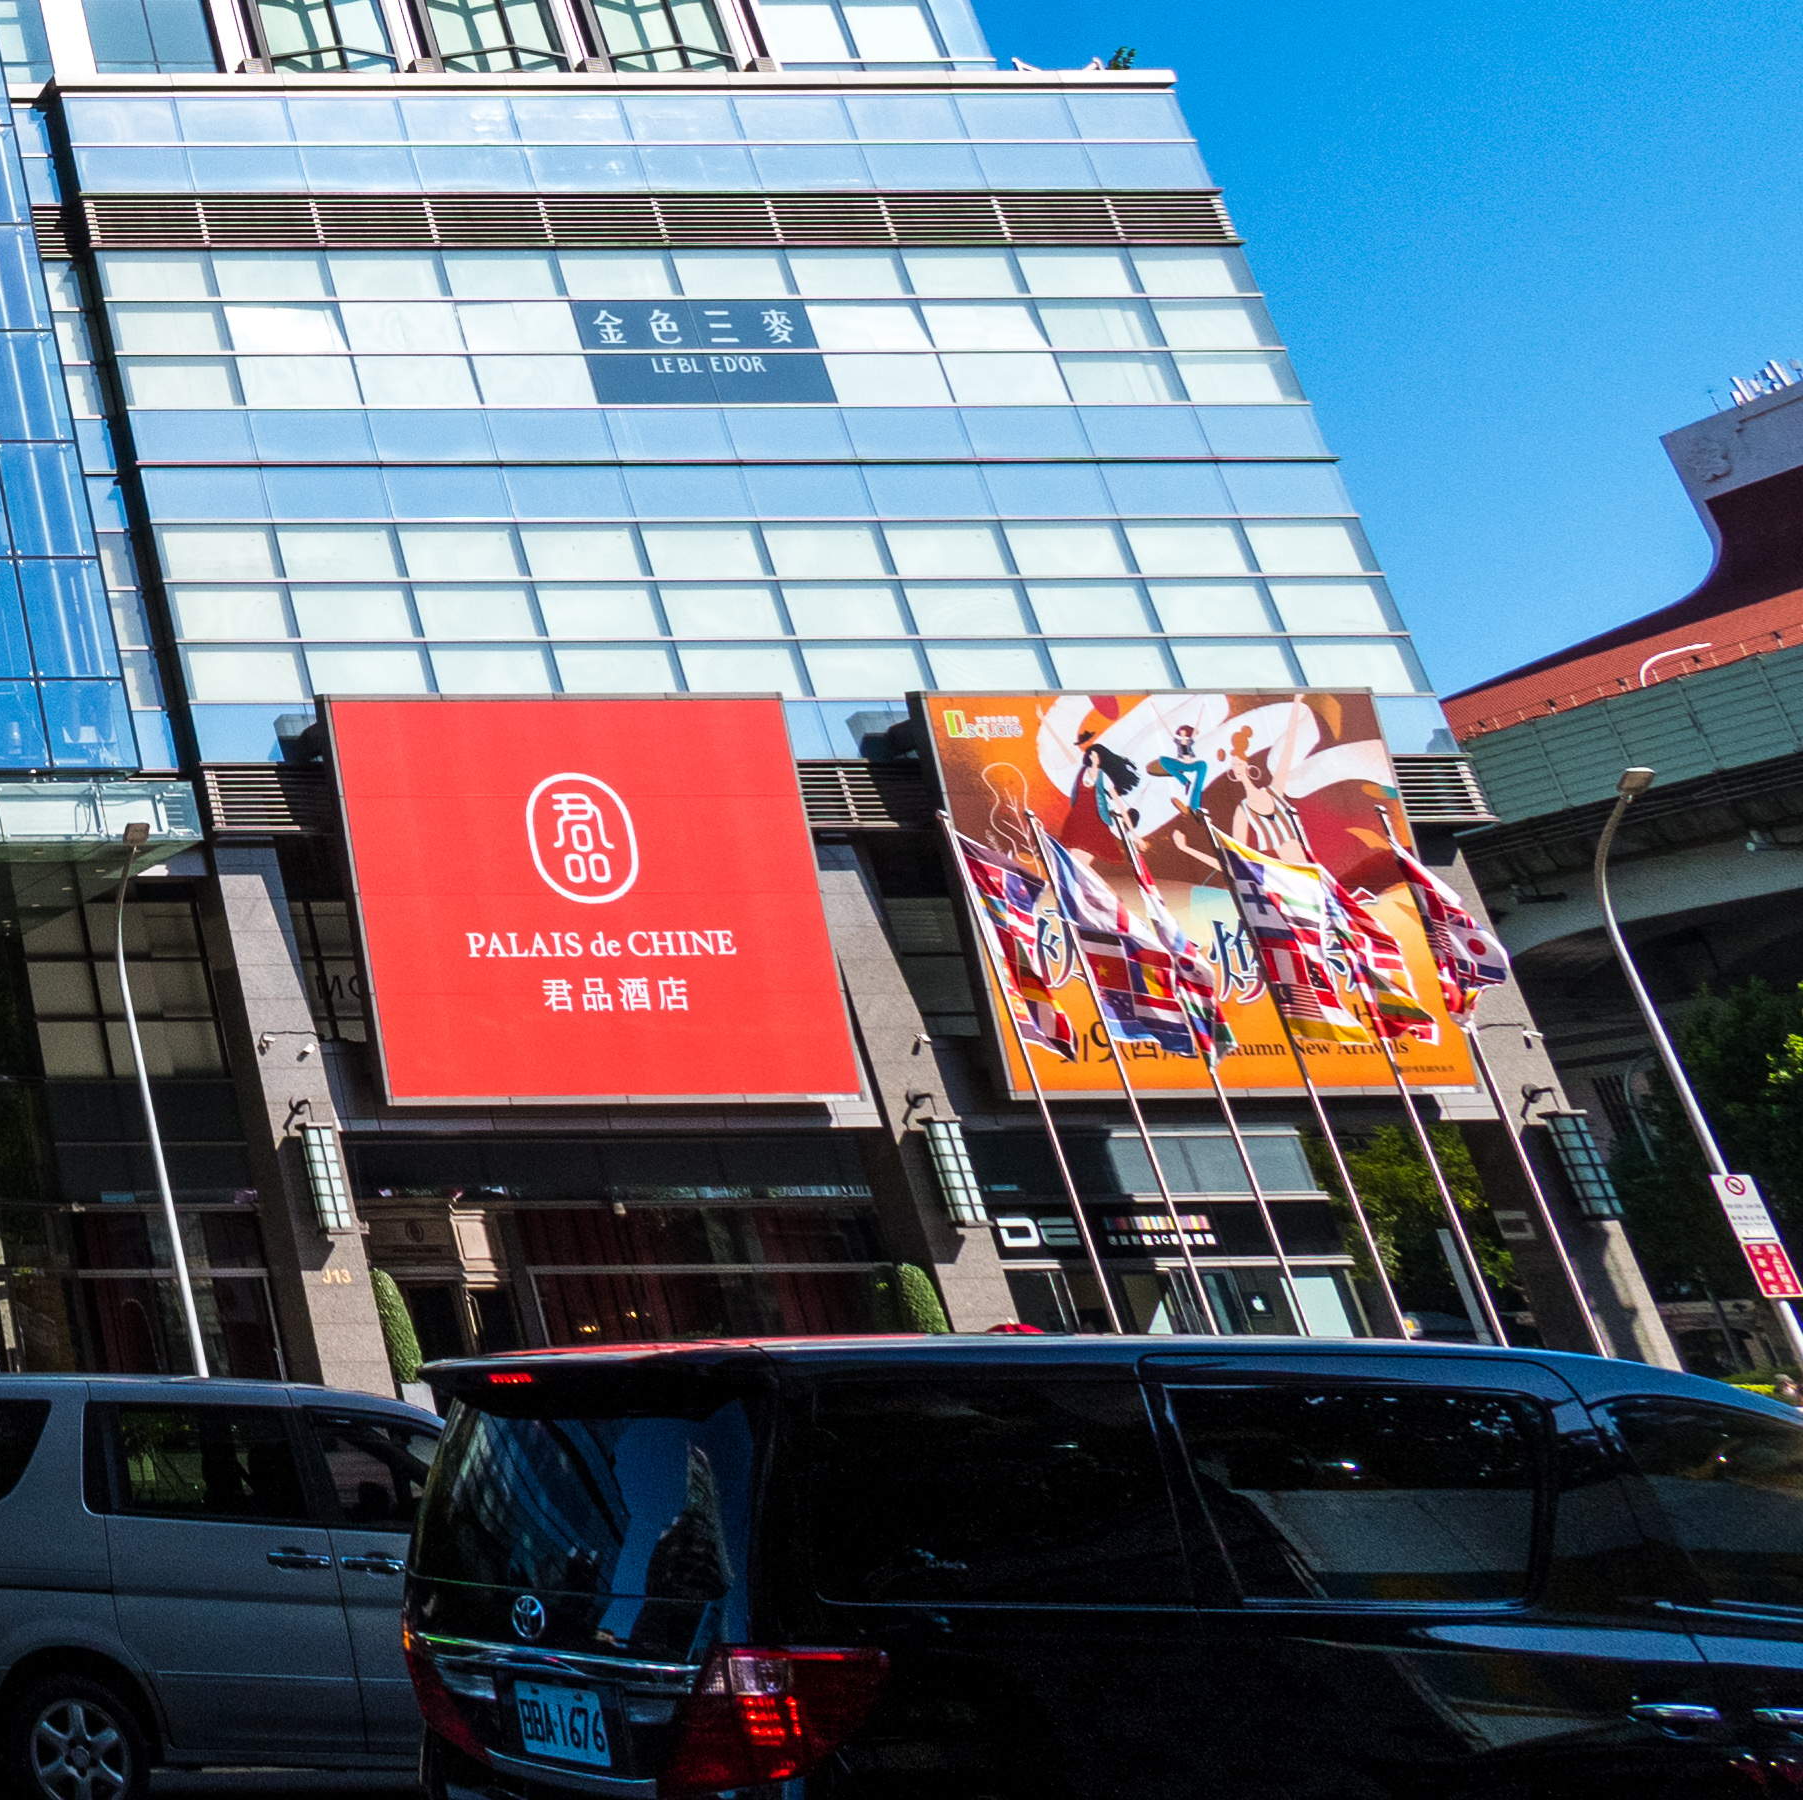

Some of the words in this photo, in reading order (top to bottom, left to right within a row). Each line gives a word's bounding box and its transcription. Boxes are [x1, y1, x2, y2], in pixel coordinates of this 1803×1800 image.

[593, 309, 794, 345] 金色三麥
[466, 930, 583, 959] PALAIS
[590, 931, 622, 959] de
[627, 929, 737, 958] CHINE
[543, 977, 691, 1013] 君品酒店
[321, 1268, 355, 1286] J13
